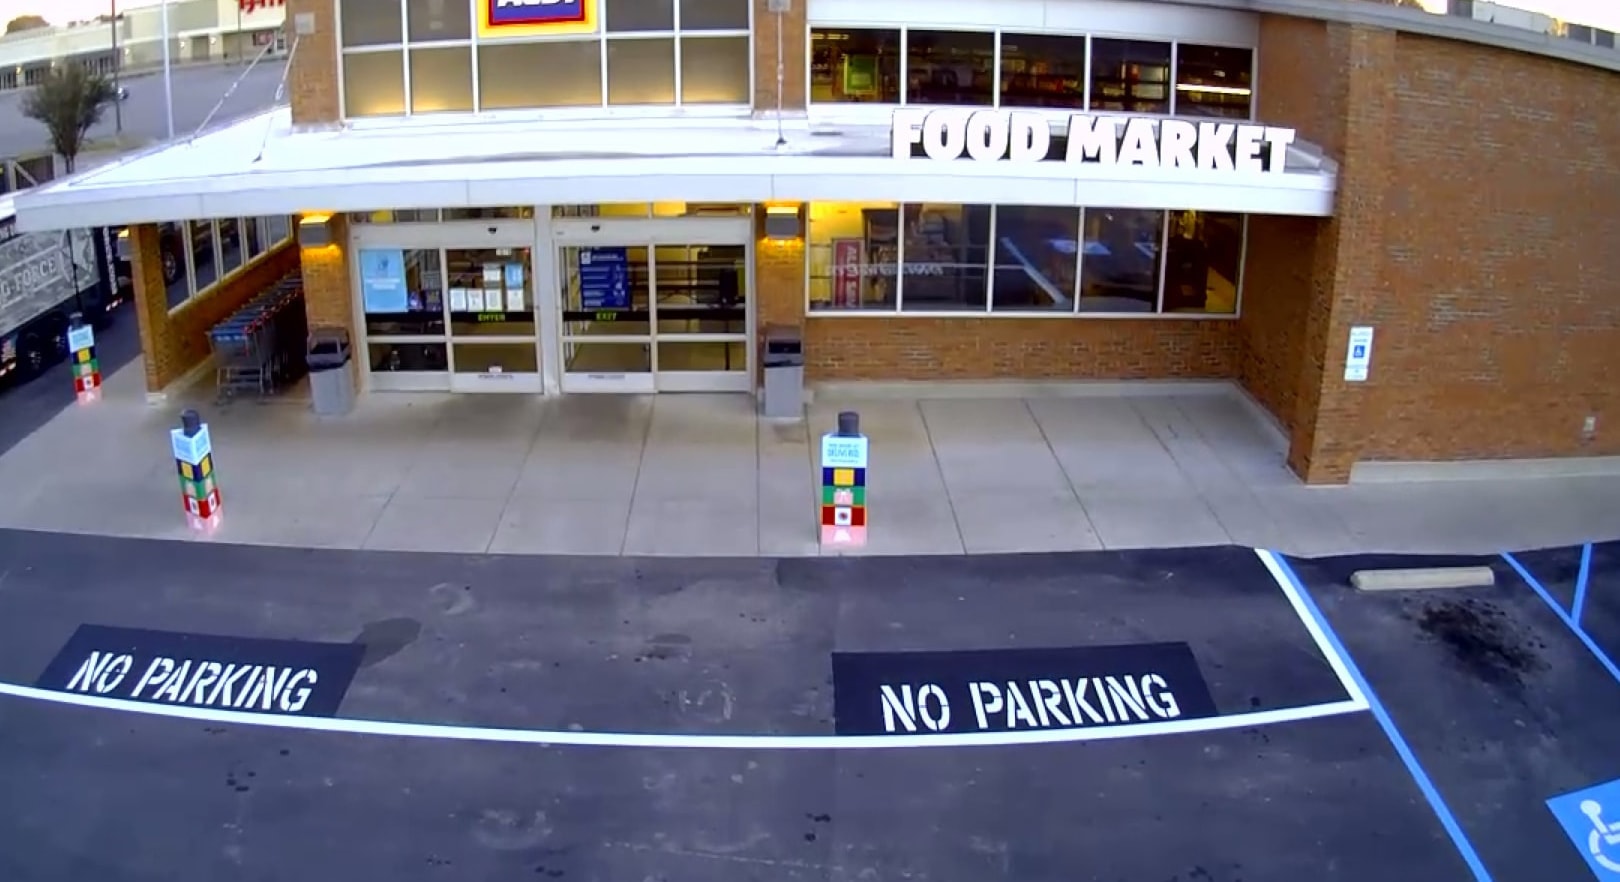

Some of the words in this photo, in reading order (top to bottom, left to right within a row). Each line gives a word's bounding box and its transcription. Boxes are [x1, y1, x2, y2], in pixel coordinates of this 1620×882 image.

[891, 107, 1050, 162] FOOD
[1065, 113, 1296, 174] MARKET
[596, 312, 616, 320] EXIT
[66, 651, 133, 693] NO
[131, 656, 318, 712] PARKING
[880, 683, 950, 732] NO
[968, 673, 1181, 729] PARKING
